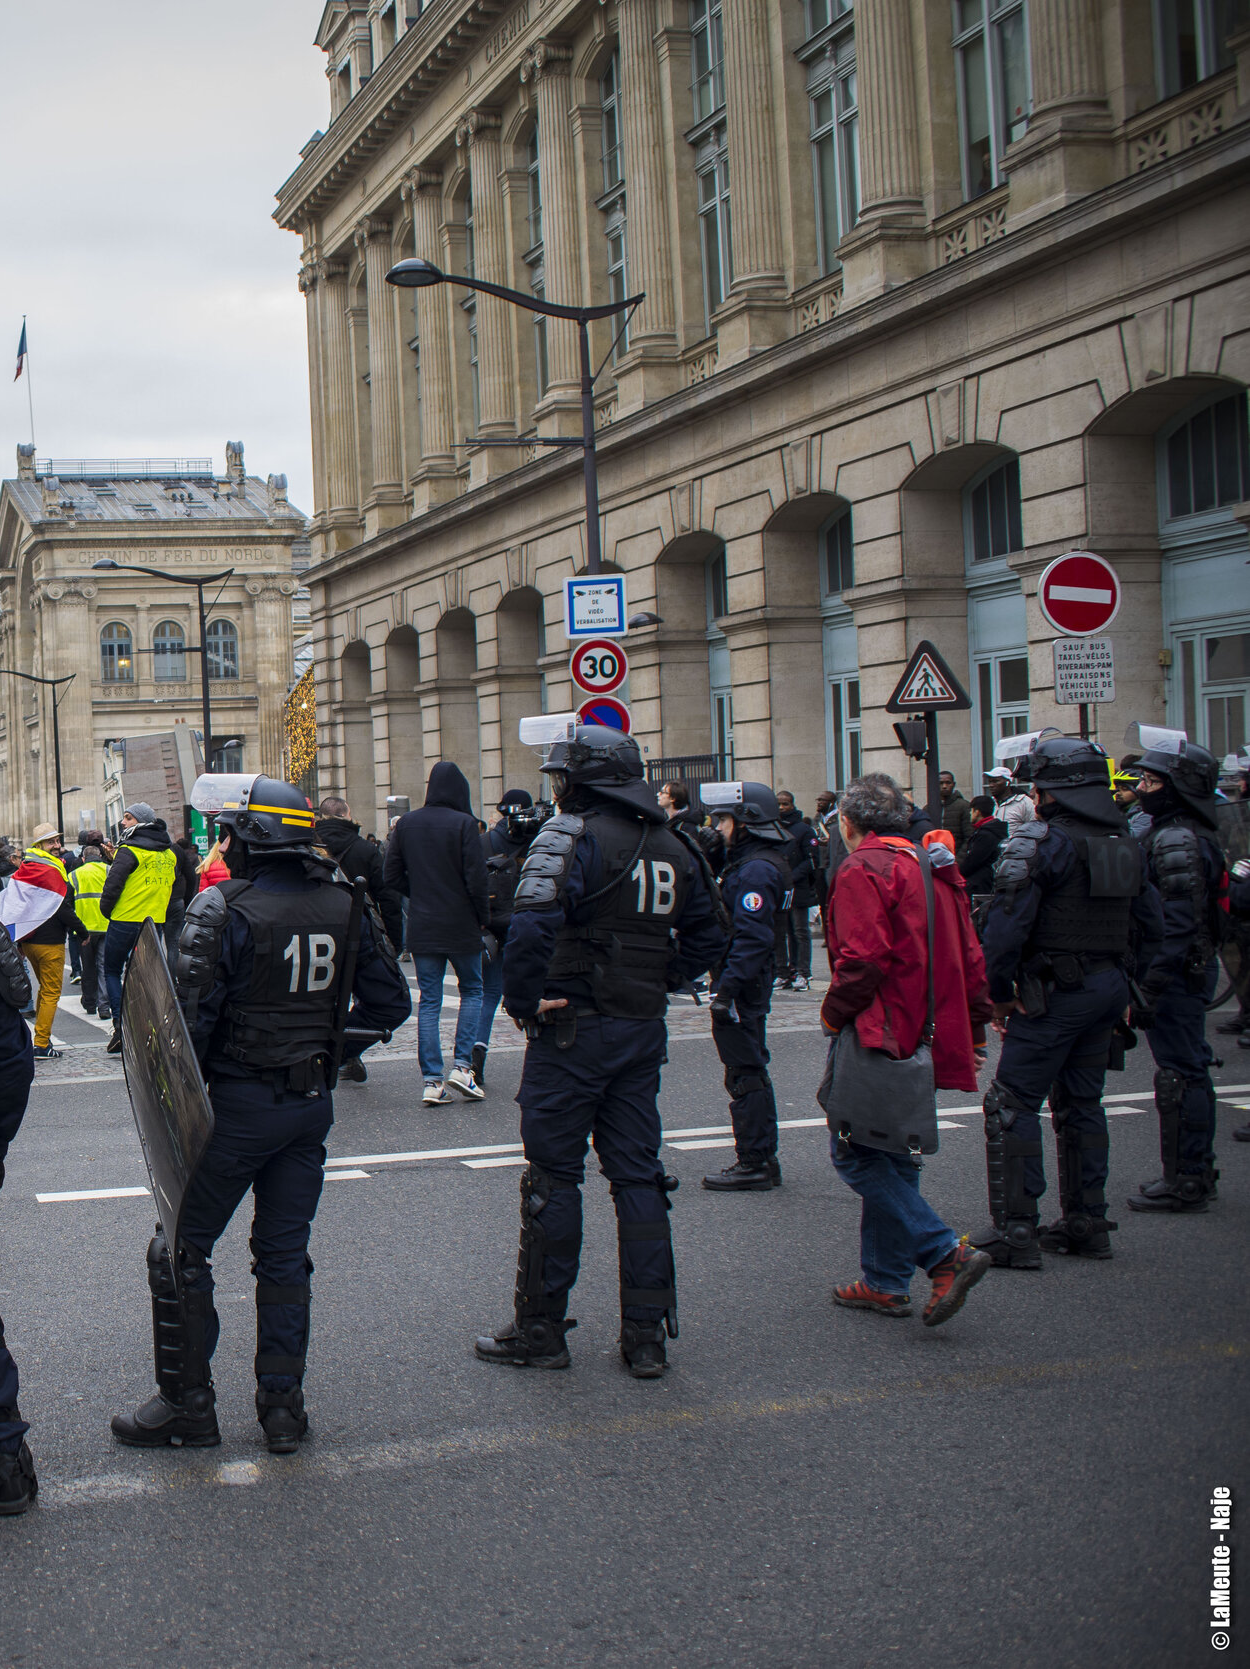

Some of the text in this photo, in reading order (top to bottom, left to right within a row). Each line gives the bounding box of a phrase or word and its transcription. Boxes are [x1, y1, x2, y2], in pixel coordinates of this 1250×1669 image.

[576, 617, 617, 625] VERBALISATION
[1062, 644, 1085, 652] SAUF
[583, 655, 617, 679] 30
[1057, 662, 1113, 671] RIVERAINS-PAM
[1059, 671, 1111, 680] LIVRAISONS
[1059, 680, 1113, 690] VÉHICULE DE
[1068, 691, 1105, 699] SERVICE
[631, 858, 677, 915] 1B
[283, 933, 337, 993] 1B
